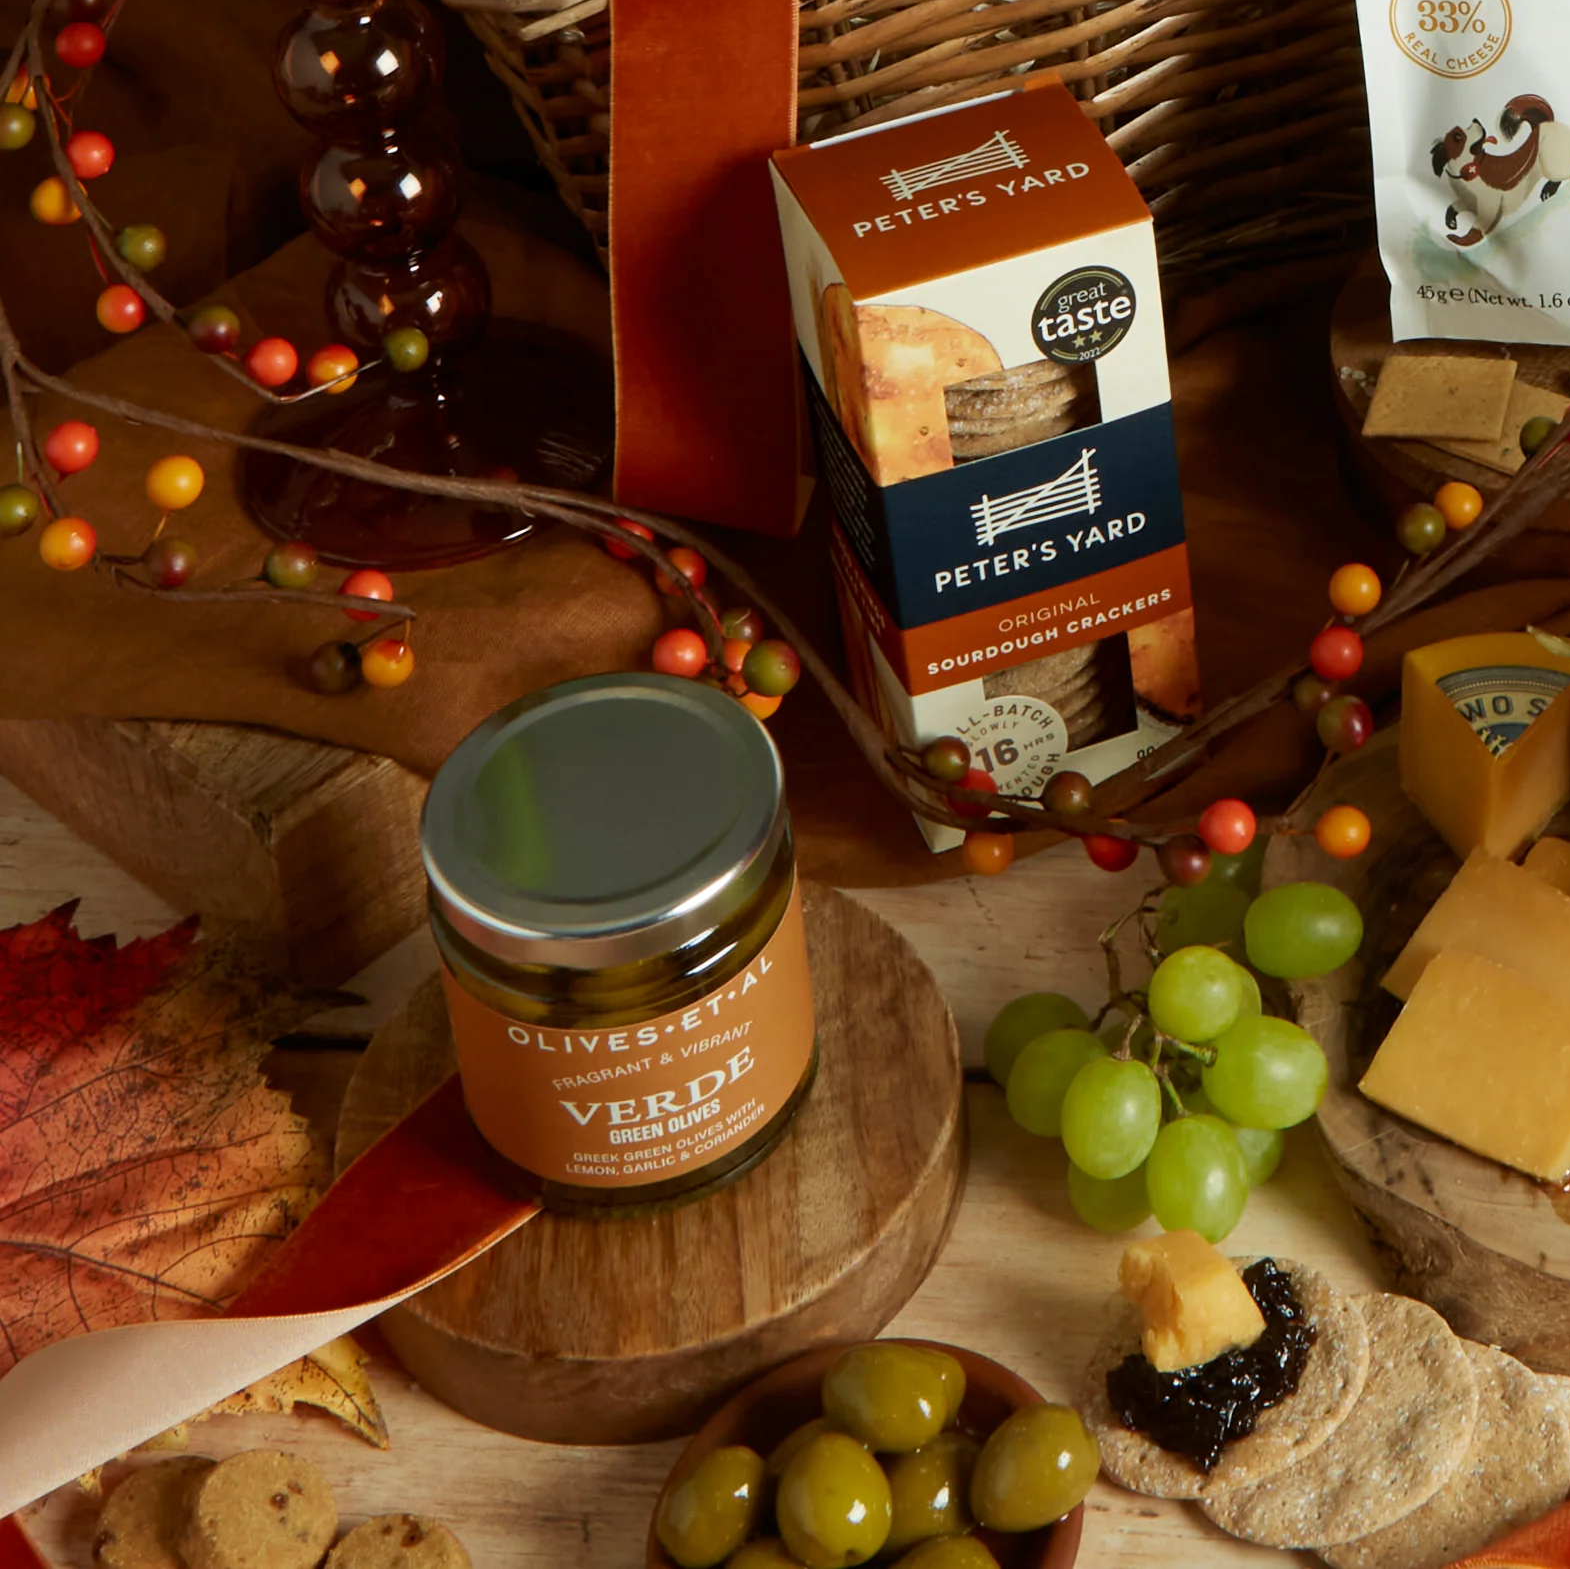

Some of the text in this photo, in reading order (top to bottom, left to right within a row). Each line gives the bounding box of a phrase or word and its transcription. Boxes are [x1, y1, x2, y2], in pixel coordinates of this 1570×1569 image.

[1417, 0, 1487, 34] 33%
[1404, 32, 1500, 70] REAL CHEESE
[853, 162, 1090, 239] PETER'S YARD
[1038, 295, 1132, 342] taste
[1058, 281, 1107, 314] great
[1468, 287, 1504, 306] (Net
[1506, 295, 1533, 308] wt.
[1539, 292, 1563, 308] 1.6
[1079, 346, 1101, 360] 2022
[934, 540, 1058, 593] PETER'S
[1065, 512, 1147, 553] YARD
[927, 588, 1172, 675] SOURDOUGH CRACKERS
[998, 592, 1101, 633] ORIGINAL
[956, 704, 1054, 735] LL-BATCH
[1457, 694, 1514, 723] WO
[975, 738, 1020, 773] 16
[1023, 732, 1056, 752] HRS
[552, 1020, 753, 1091] FRAGRANT & VIBRANT
[558, 1045, 755, 1126] VERDE
[565, 1103, 766, 1176] LEMON, GARLIC & CORIANDER
[573, 1097, 757, 1163] GREEK GREEN OLIVES WITH
[609, 1098, 722, 1145] GREEN OLIVES
